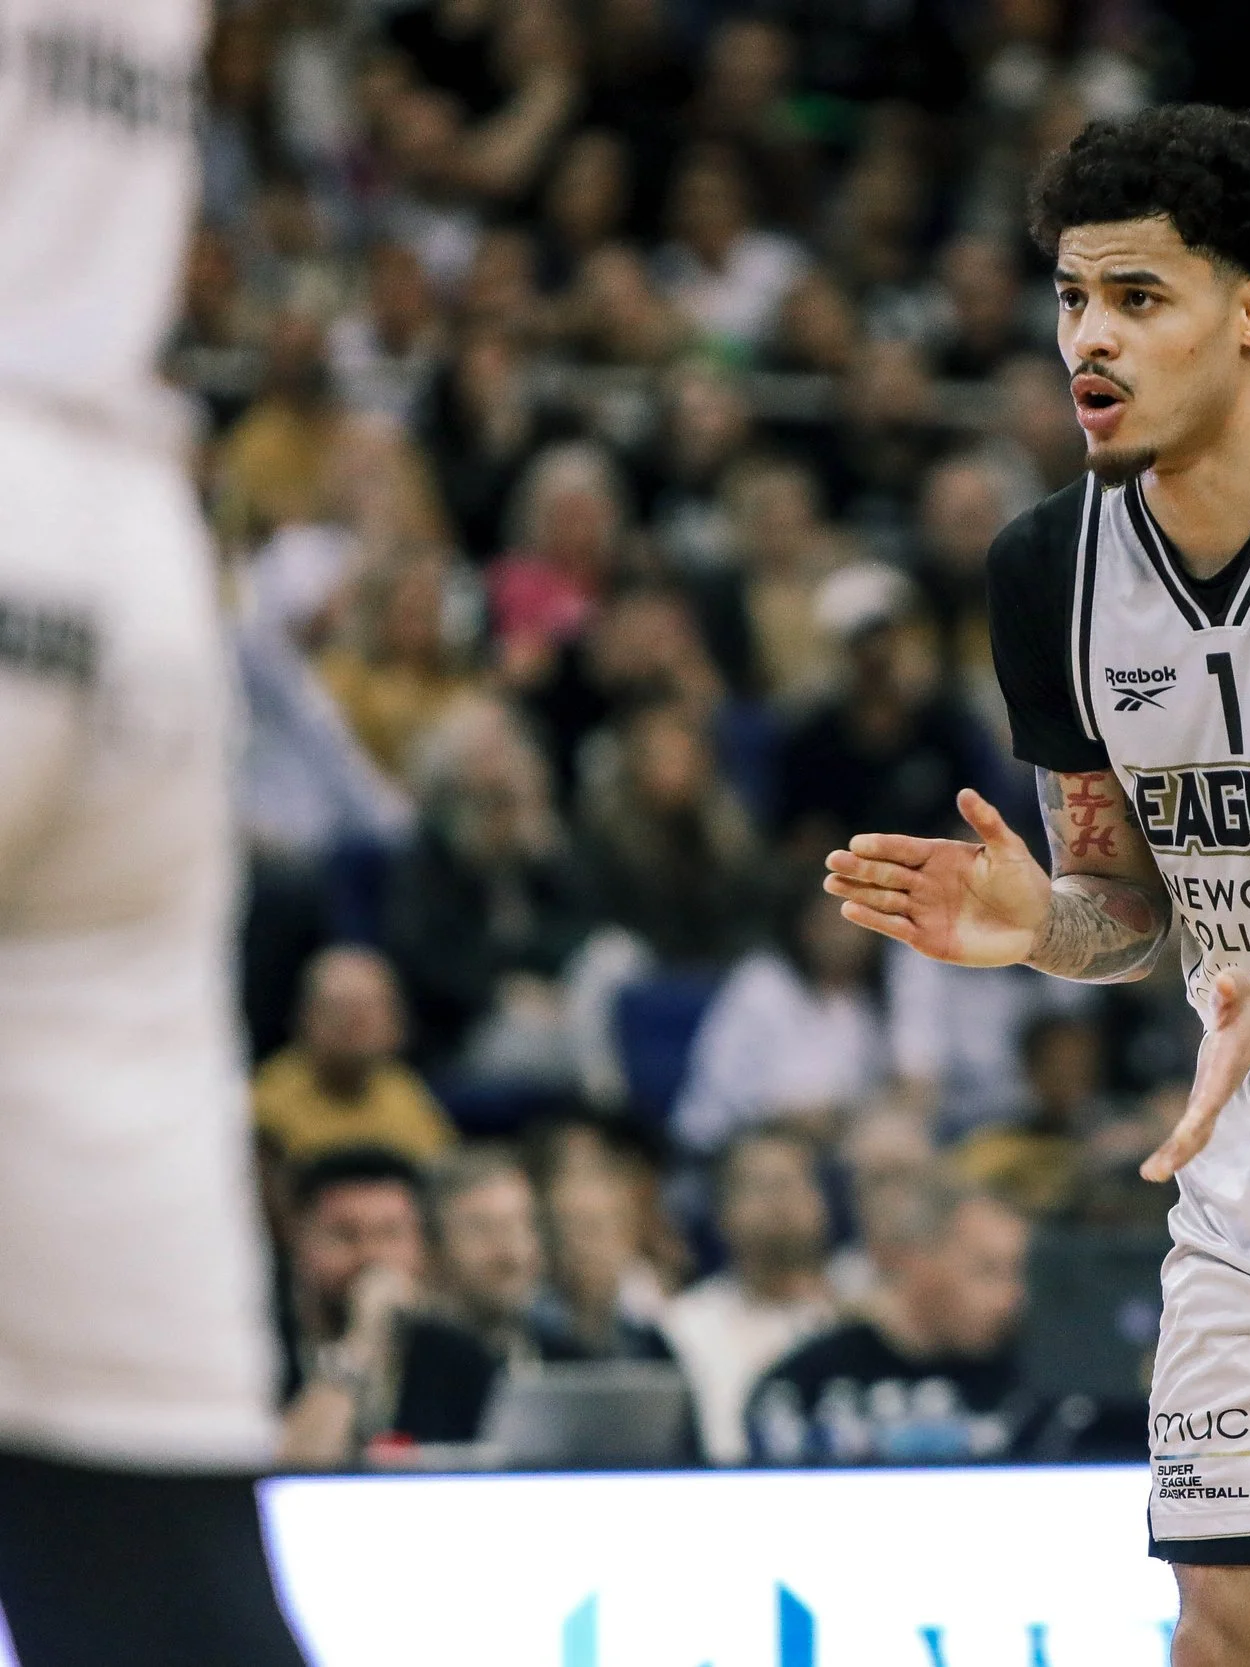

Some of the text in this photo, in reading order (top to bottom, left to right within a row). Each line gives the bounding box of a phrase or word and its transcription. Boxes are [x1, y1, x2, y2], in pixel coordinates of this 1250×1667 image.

[1105, 667, 1177, 685] Reebok
[1206, 652, 1244, 755] 1
[1158, 1464, 1194, 1476] SUPER
[1157, 1476, 1202, 1487] EAGUE
[1160, 1487, 1249, 1499] BASKETBALL
